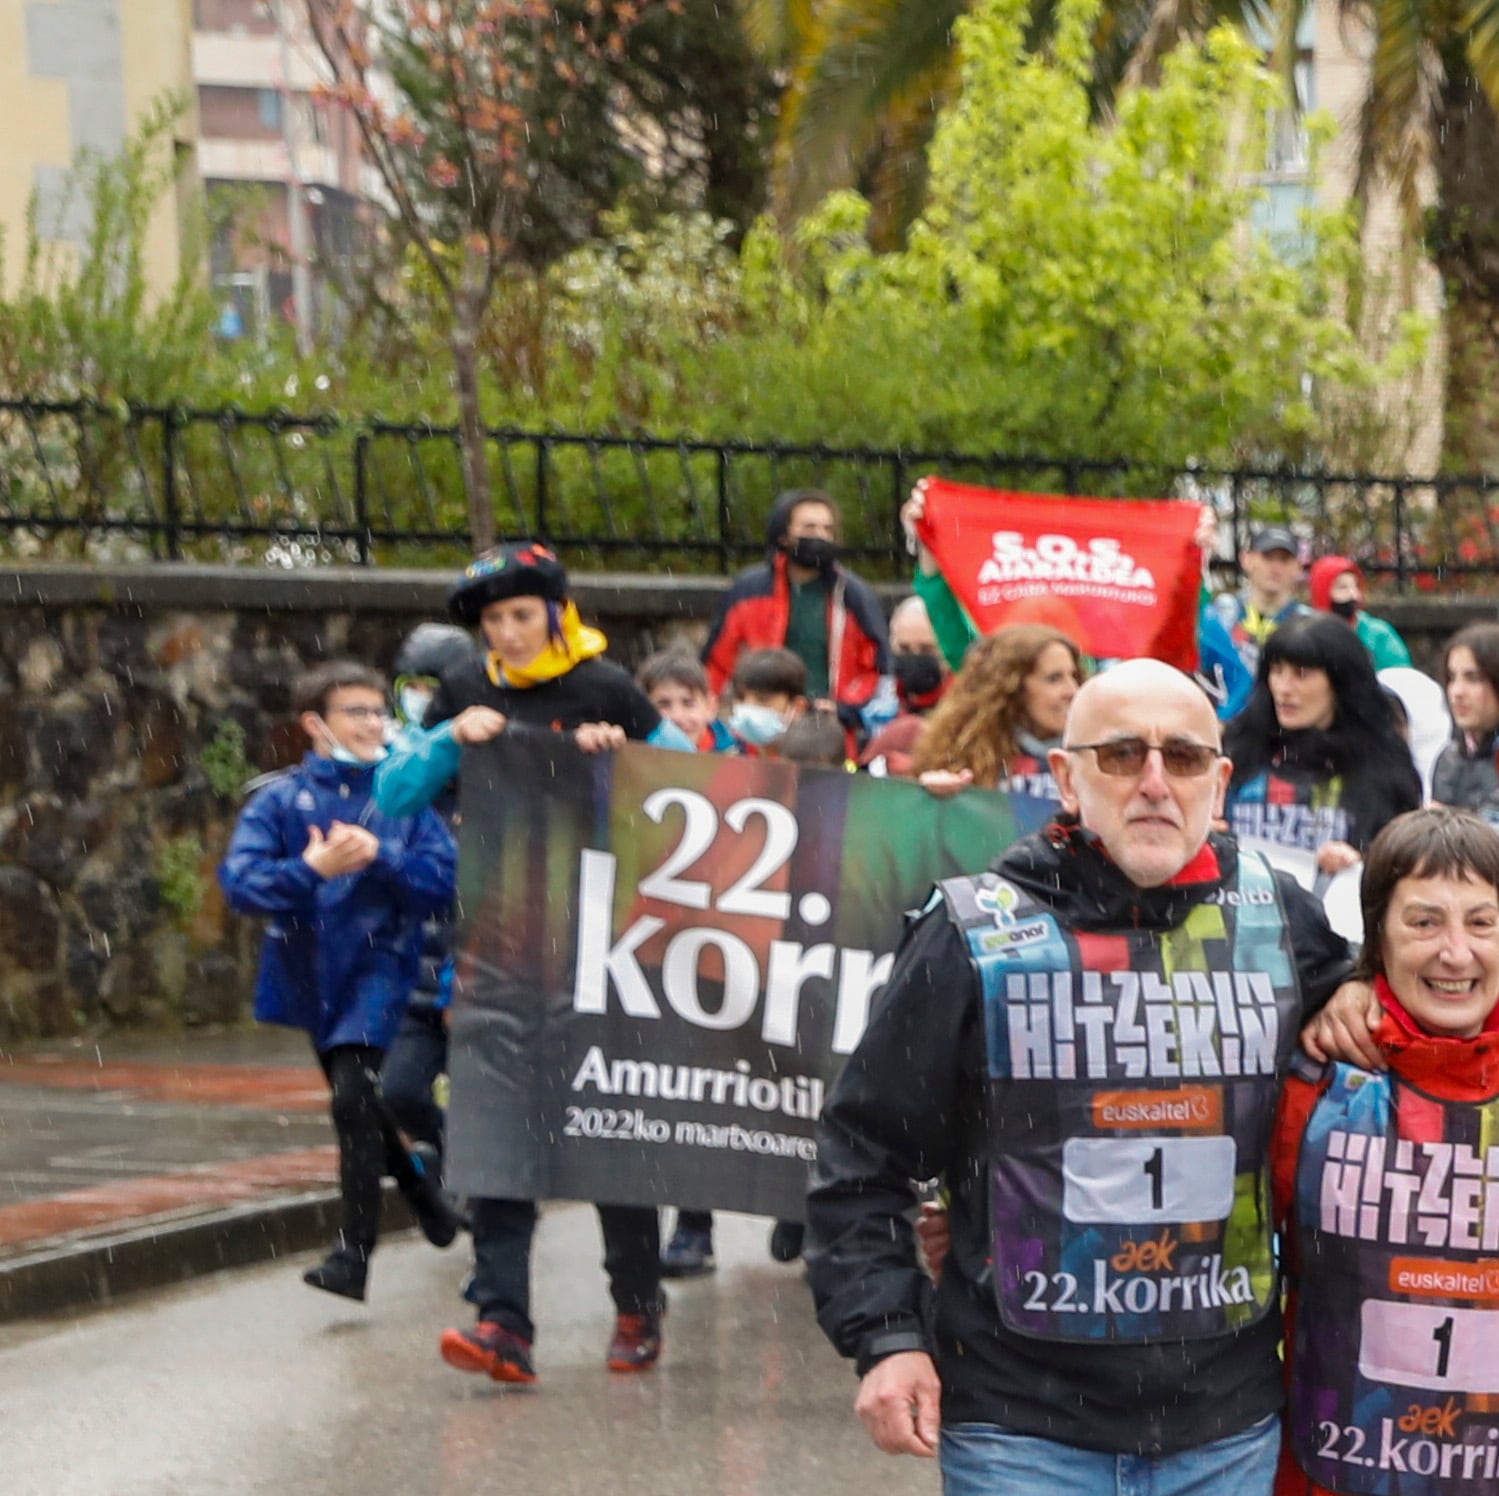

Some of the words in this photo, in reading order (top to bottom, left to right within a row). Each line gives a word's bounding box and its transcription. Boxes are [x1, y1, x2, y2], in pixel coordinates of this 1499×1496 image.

[637, 787, 831, 926] 22.
[574, 848, 895, 1055] korr
[1005, 971, 1279, 1080] HITZEKIN
[562, 1105, 671, 1144] 2022ko
[1102, 1099, 1191, 1123] euskaltel
[1143, 1147, 1163, 1210] 1
[1111, 1228, 1179, 1272] aek
[1397, 1271, 1485, 1295] euskaltel
[1432, 1316, 1454, 1378] 1
[1397, 1395, 1462, 1438] aek
